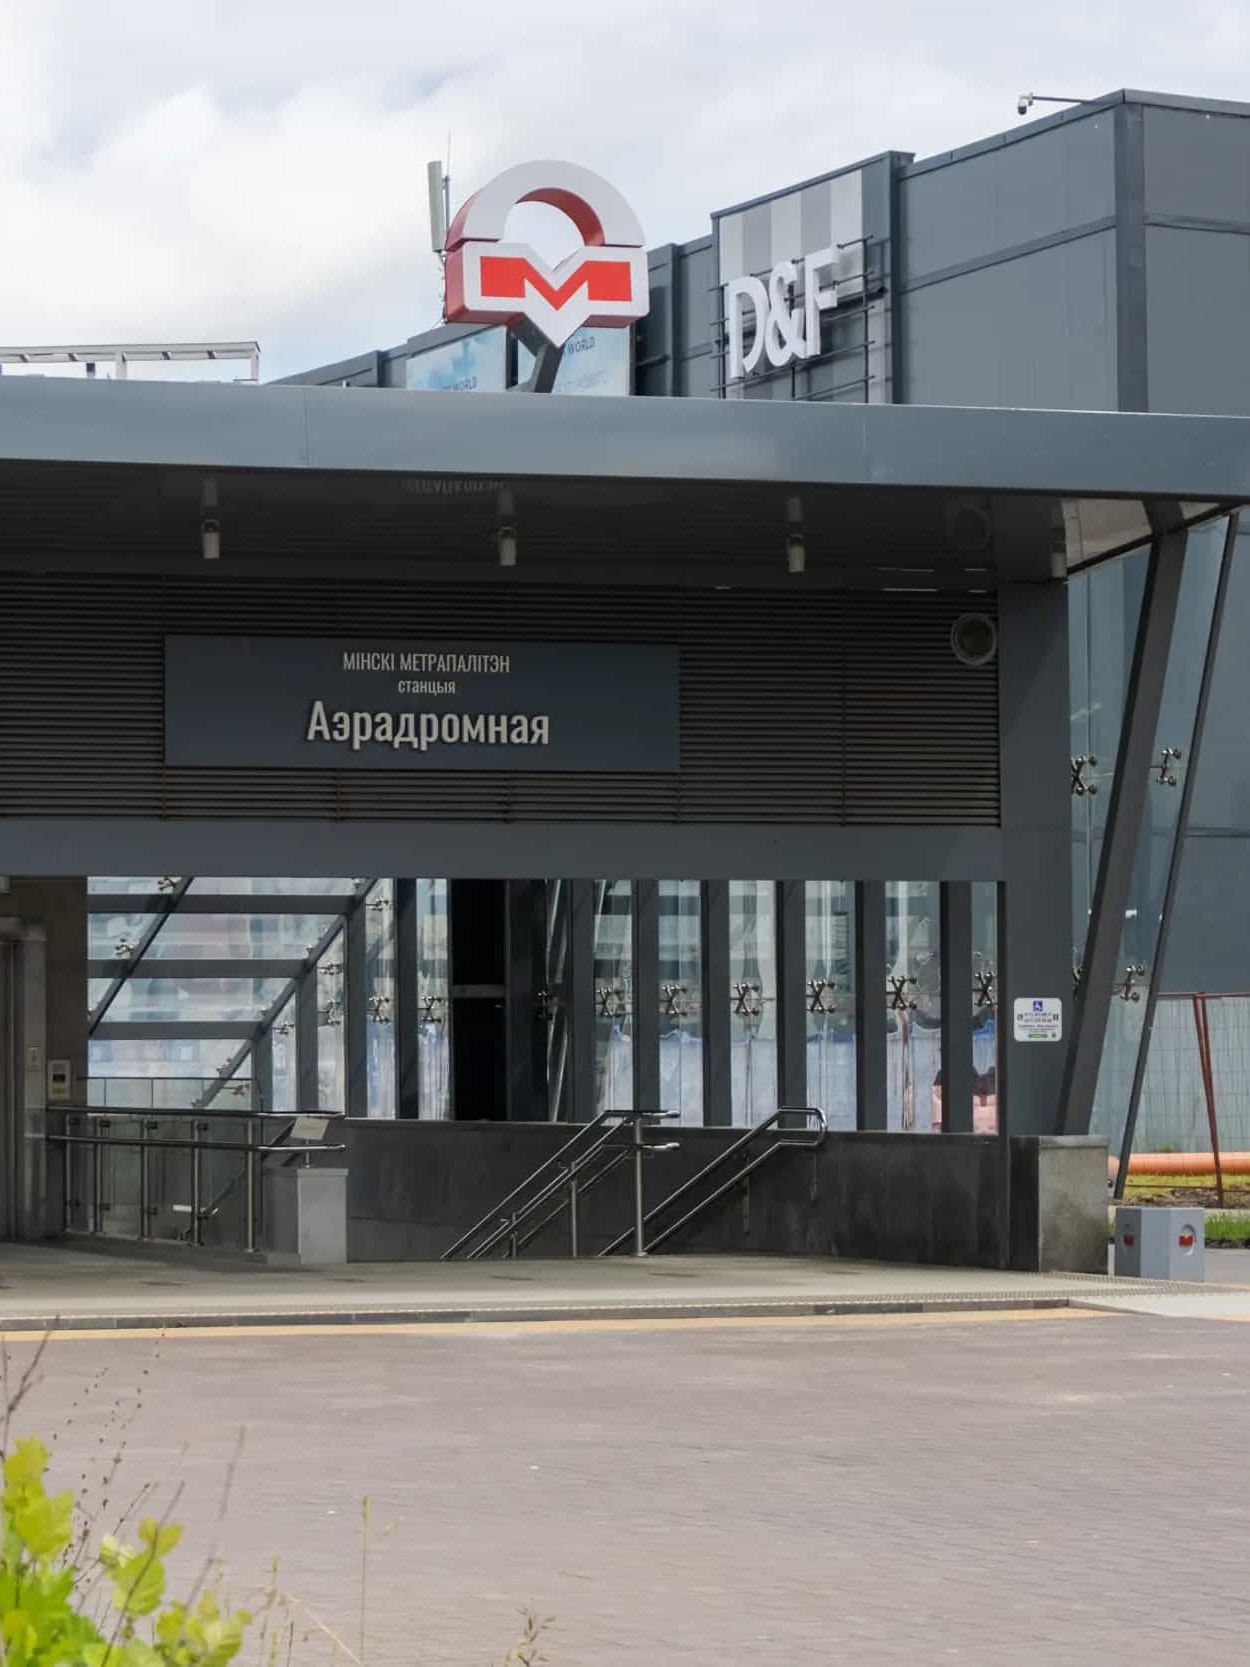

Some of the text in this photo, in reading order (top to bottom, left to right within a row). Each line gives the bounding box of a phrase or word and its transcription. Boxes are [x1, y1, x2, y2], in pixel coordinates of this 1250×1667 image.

[727, 243, 844, 380] D&F
[567, 335, 596, 354] WORLD
[343, 651, 510, 673] МІНСКІ МЕТРАПАЛІТЭН
[398, 680, 456, 696] станцыя
[307, 700, 550, 751] Аэрадромная
